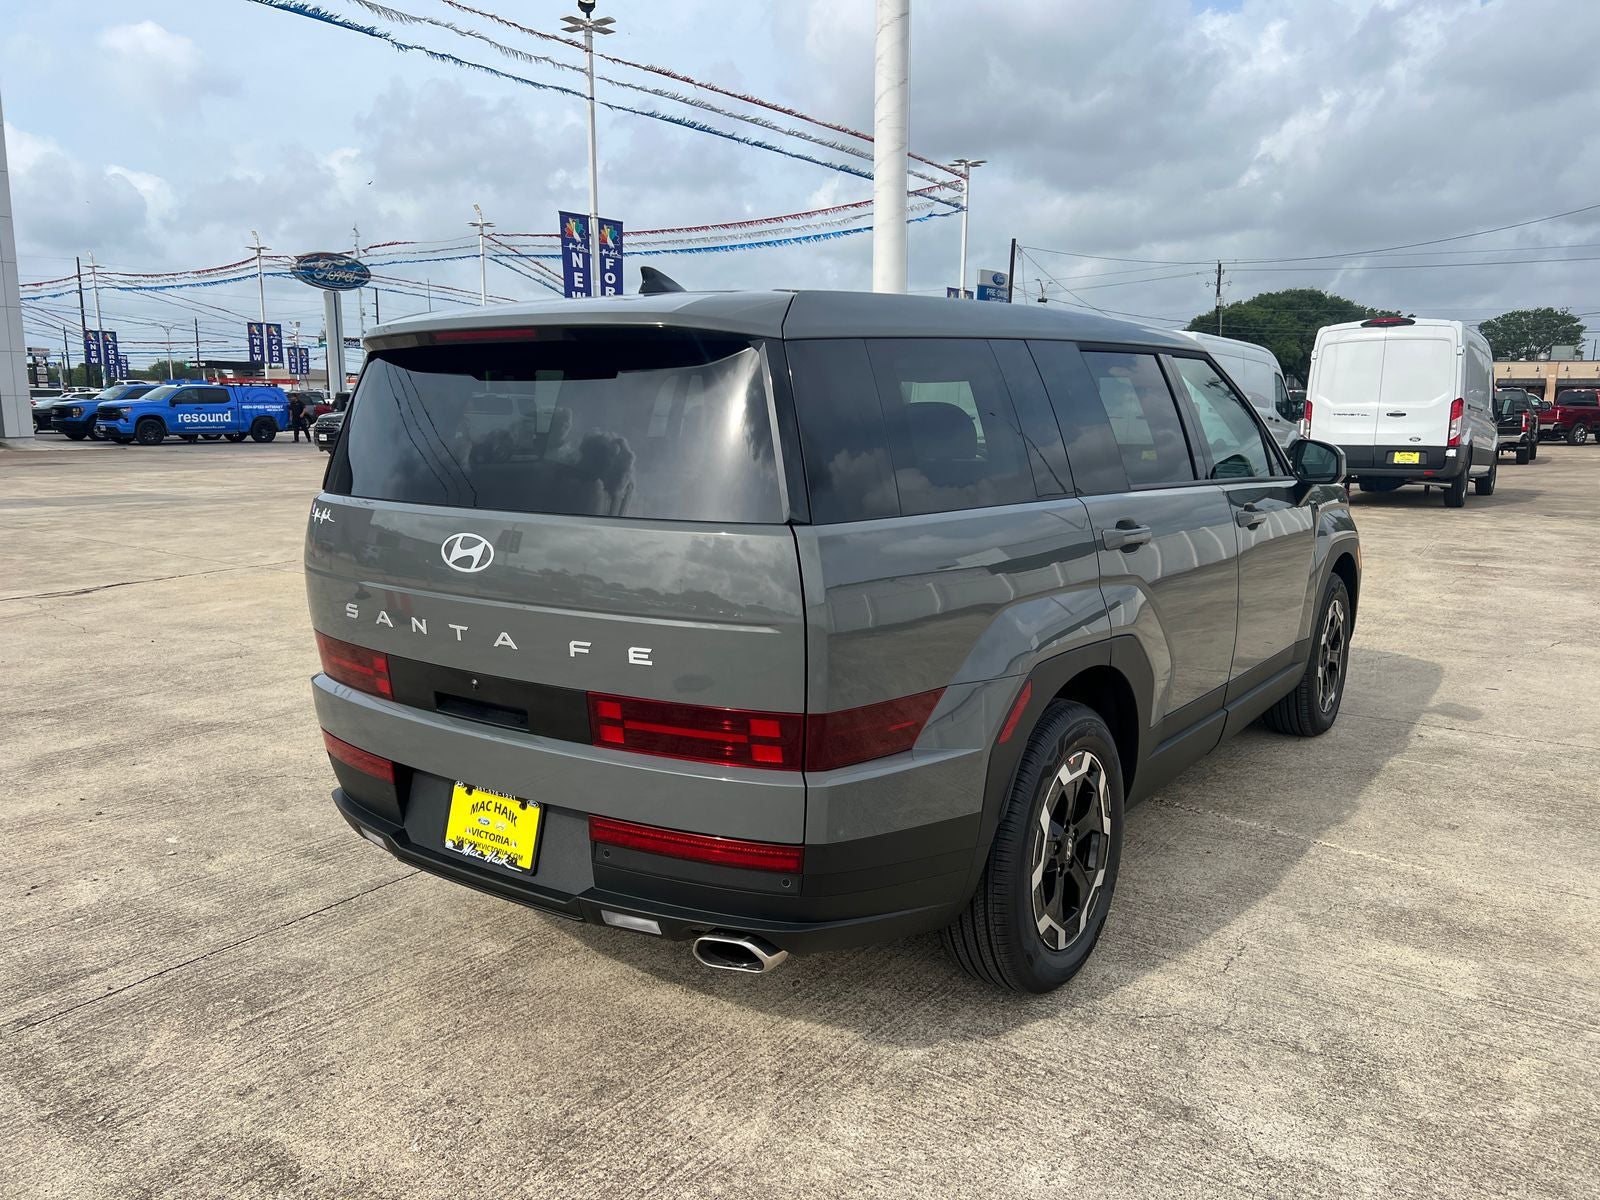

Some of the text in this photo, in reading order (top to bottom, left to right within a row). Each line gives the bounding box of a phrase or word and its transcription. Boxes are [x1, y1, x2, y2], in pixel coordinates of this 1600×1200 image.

[90, 343, 99, 364] NEW
[107, 344, 116, 365] FORD
[253, 338, 262, 361] NEW
[272, 339, 280, 362] FORD
[178, 410, 232, 423] resound
[345, 602, 653, 666] SANTA FE
[470, 800, 518, 827] MAC HAIK
[471, 827, 510, 847] VICTORIA
[457, 843, 516, 868] Mac Haik
